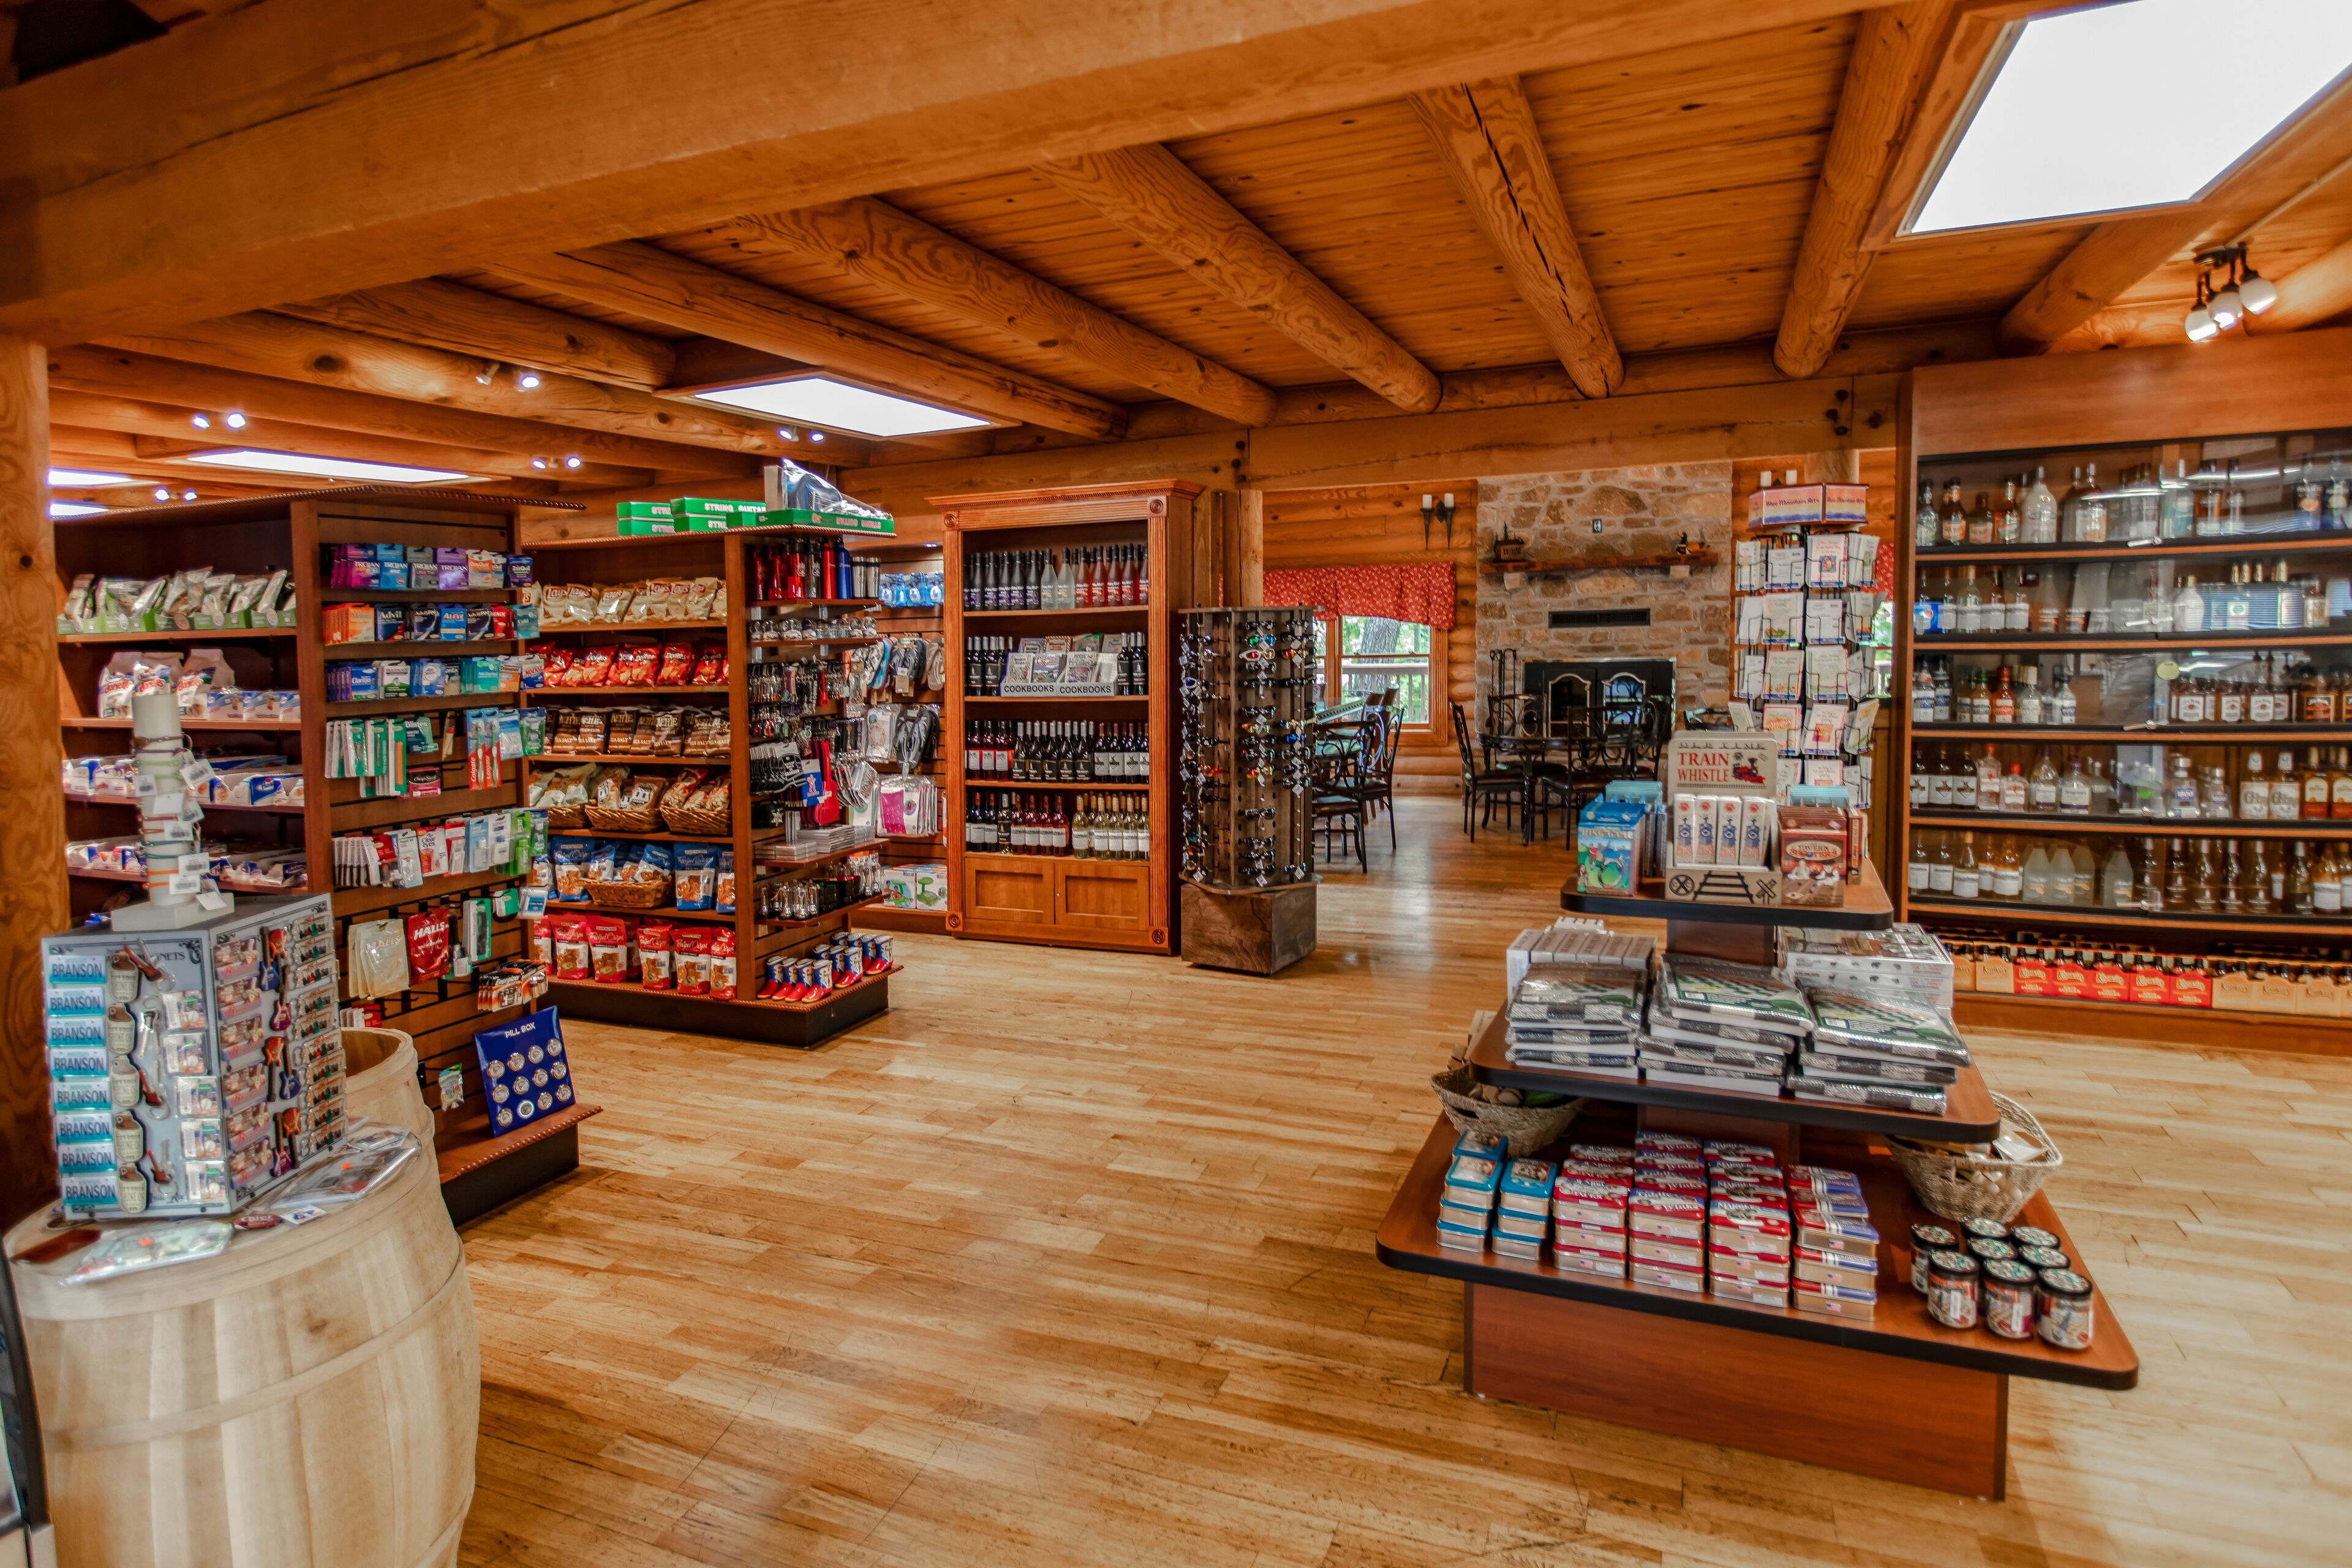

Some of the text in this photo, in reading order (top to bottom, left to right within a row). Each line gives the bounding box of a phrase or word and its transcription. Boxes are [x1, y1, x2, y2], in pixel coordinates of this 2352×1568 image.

[704, 503, 767, 513] STRING GUITAR
[1060, 685, 1112, 694] COOKBOOKS
[404, 720, 428, 729] Blistex
[1677, 752, 1730, 766] TRAIN
[1676, 768, 1730, 783] WHISTLE
[414, 921, 445, 940] HALLS
[53, 963, 103, 977] BRANSON
[496, 975, 520, 986] Energizer
[50, 995, 101, 1011] BRANSON
[51, 1027, 102, 1041] BRANSON
[505, 1022, 536, 1039] PILL BOX
[54, 1057, 105, 1071] BRANSON
[57, 1090, 107, 1104] BRANSON
[60, 1121, 110, 1137] BRANSON
[62, 1152, 112, 1167] BRANSON
[66, 1185, 116, 1199] BRANSON
[1661, 1203, 1701, 1212] Winks
[1717, 1201, 1760, 1211] MARBLES
